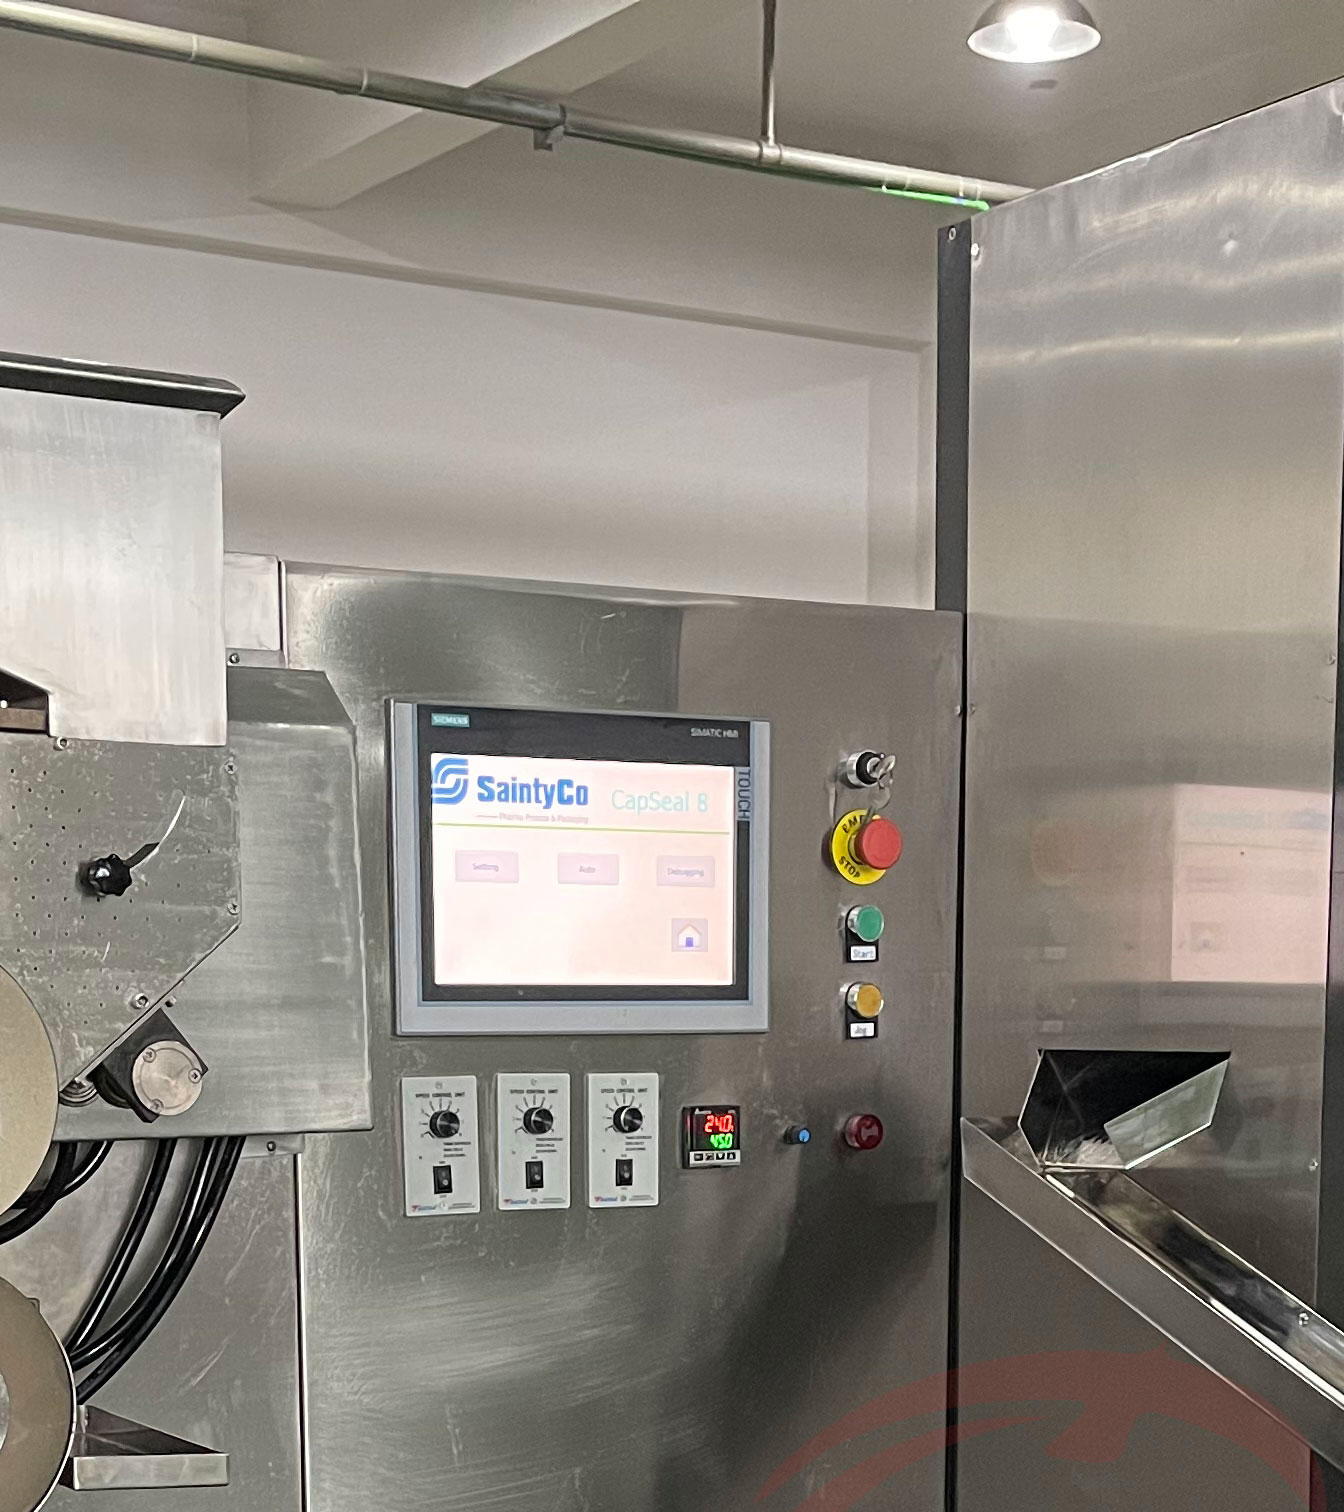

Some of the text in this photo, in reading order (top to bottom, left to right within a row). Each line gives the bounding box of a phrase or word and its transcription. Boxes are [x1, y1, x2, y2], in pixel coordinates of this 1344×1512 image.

[477, 775, 589, 809] SaintyCo
[611, 789, 690, 815] CapSeal
[738, 769, 751, 819] TOUCH
[839, 856, 861, 878] STOP
